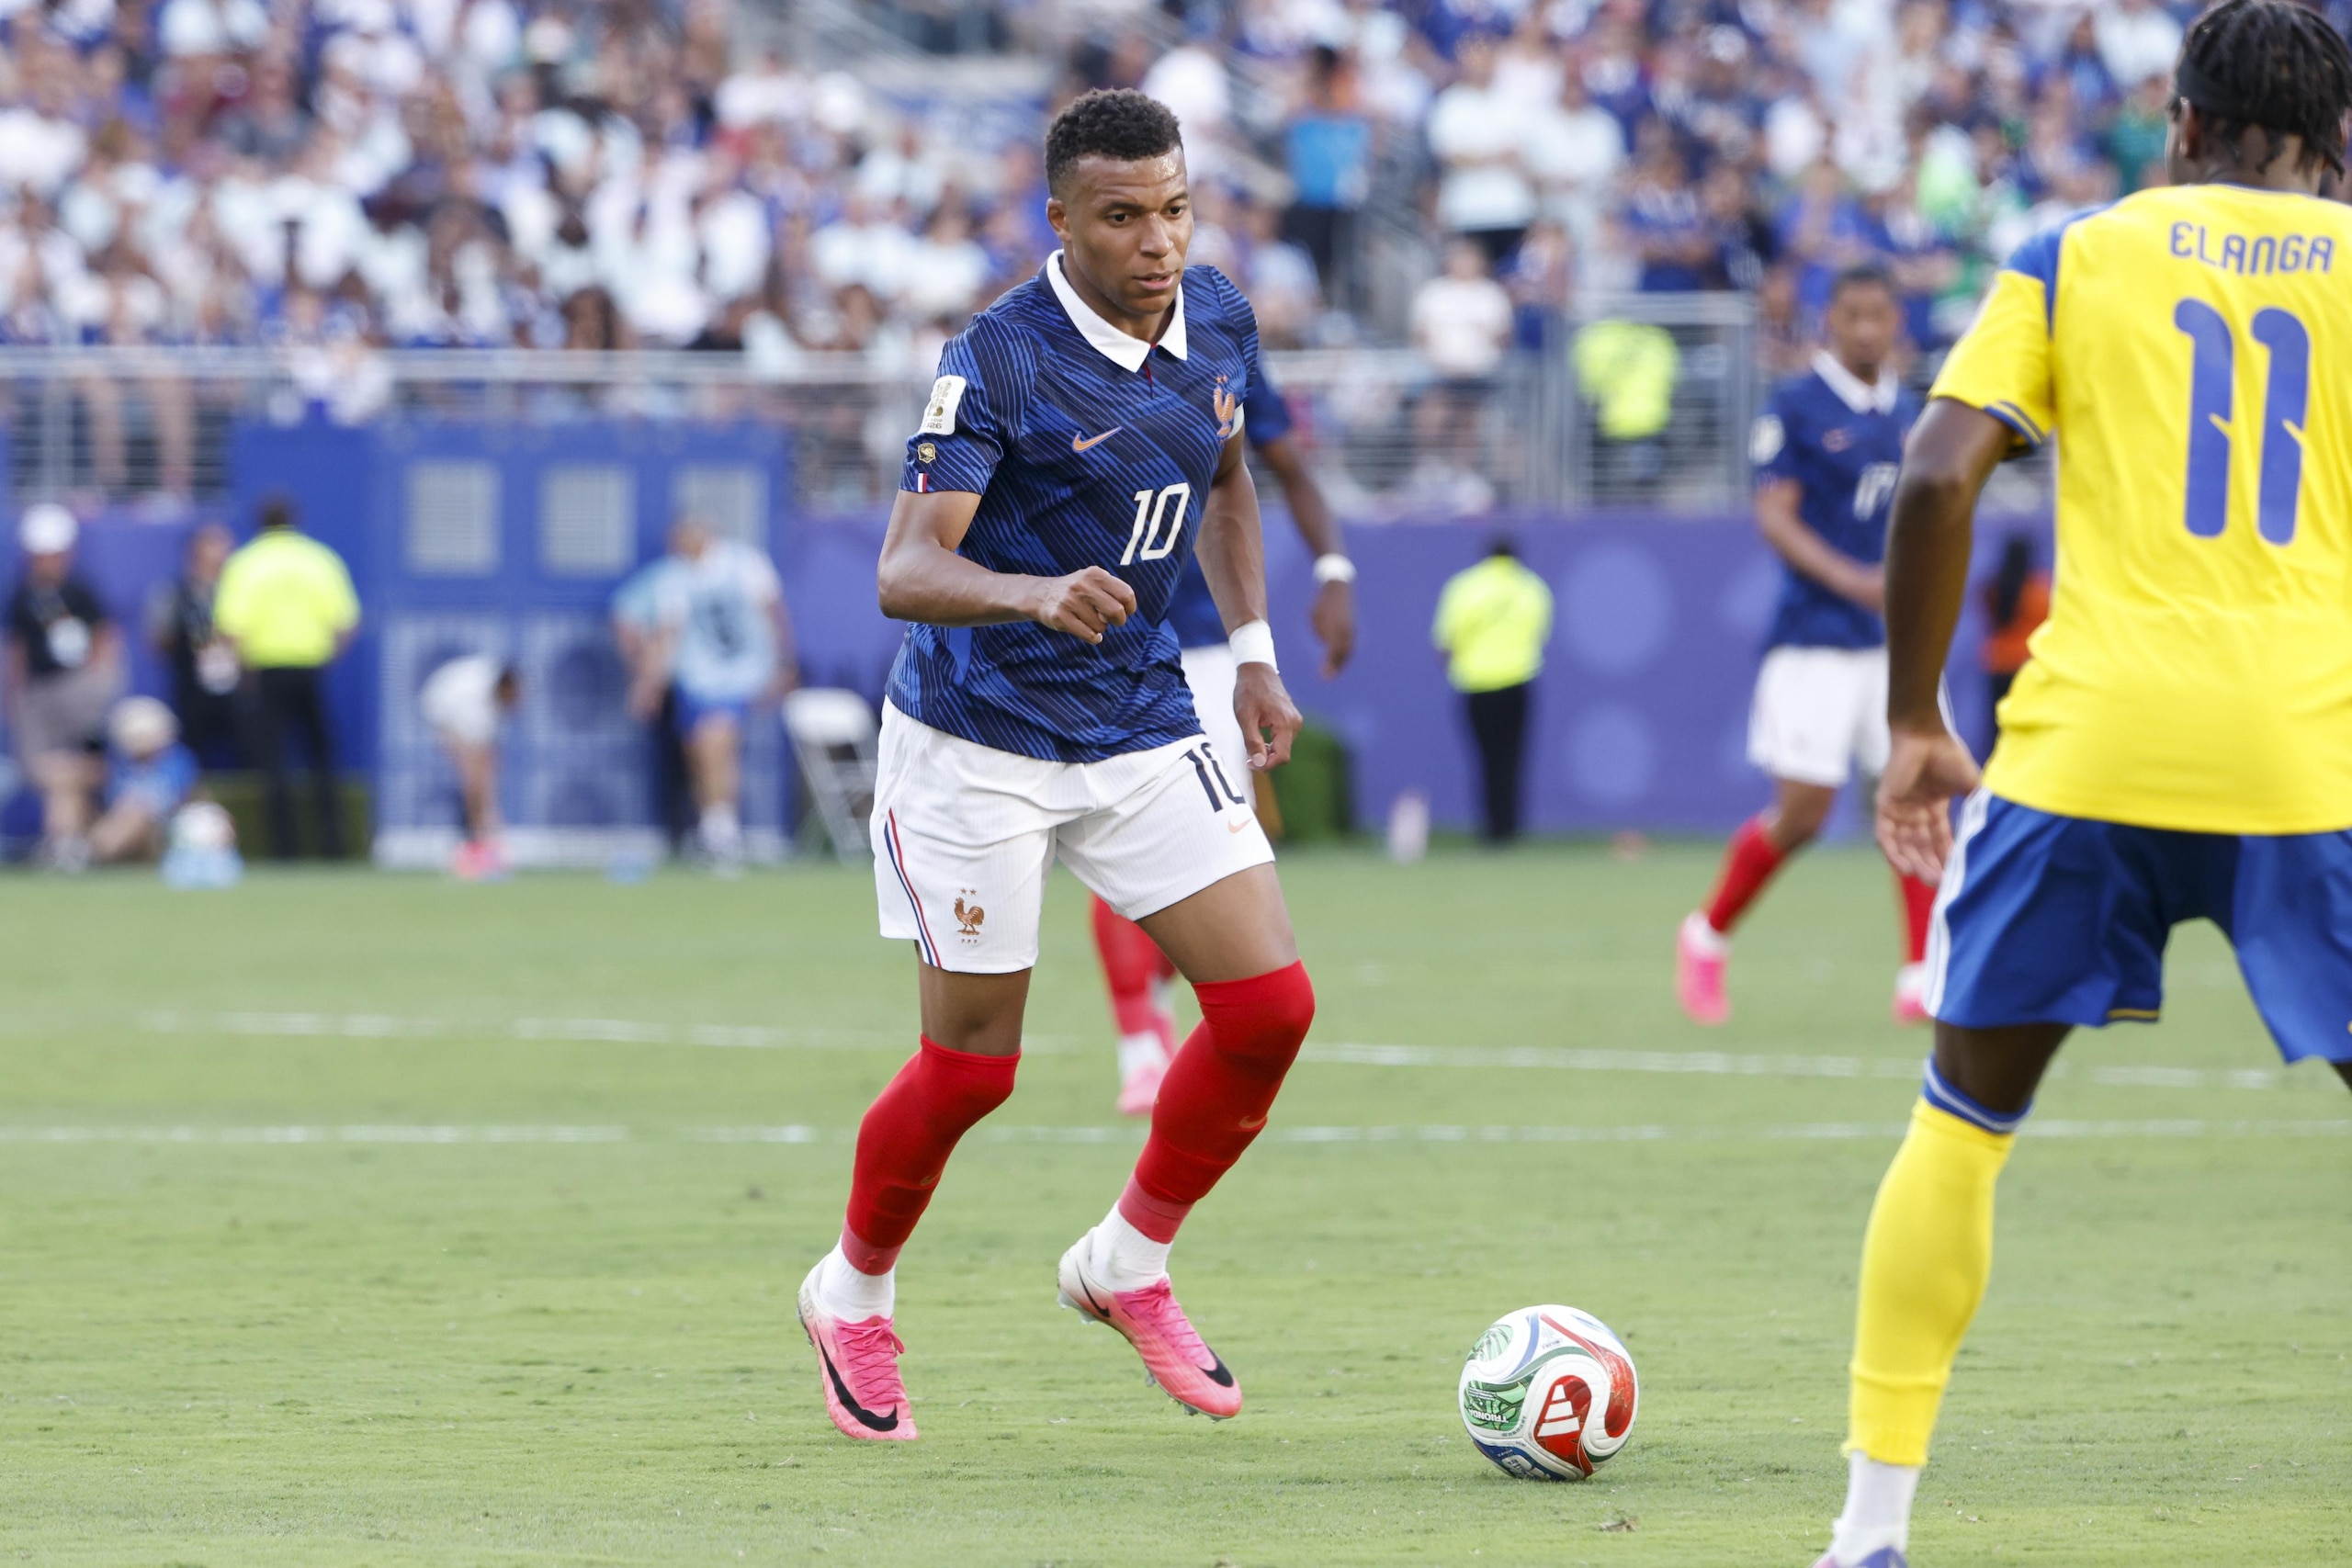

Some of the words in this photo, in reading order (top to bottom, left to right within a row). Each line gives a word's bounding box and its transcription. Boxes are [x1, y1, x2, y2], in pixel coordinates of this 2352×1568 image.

[2170, 221, 2334, 275] ELANGA
[2173, 297, 2312, 547] 11
[1120, 482, 1191, 566] 10
